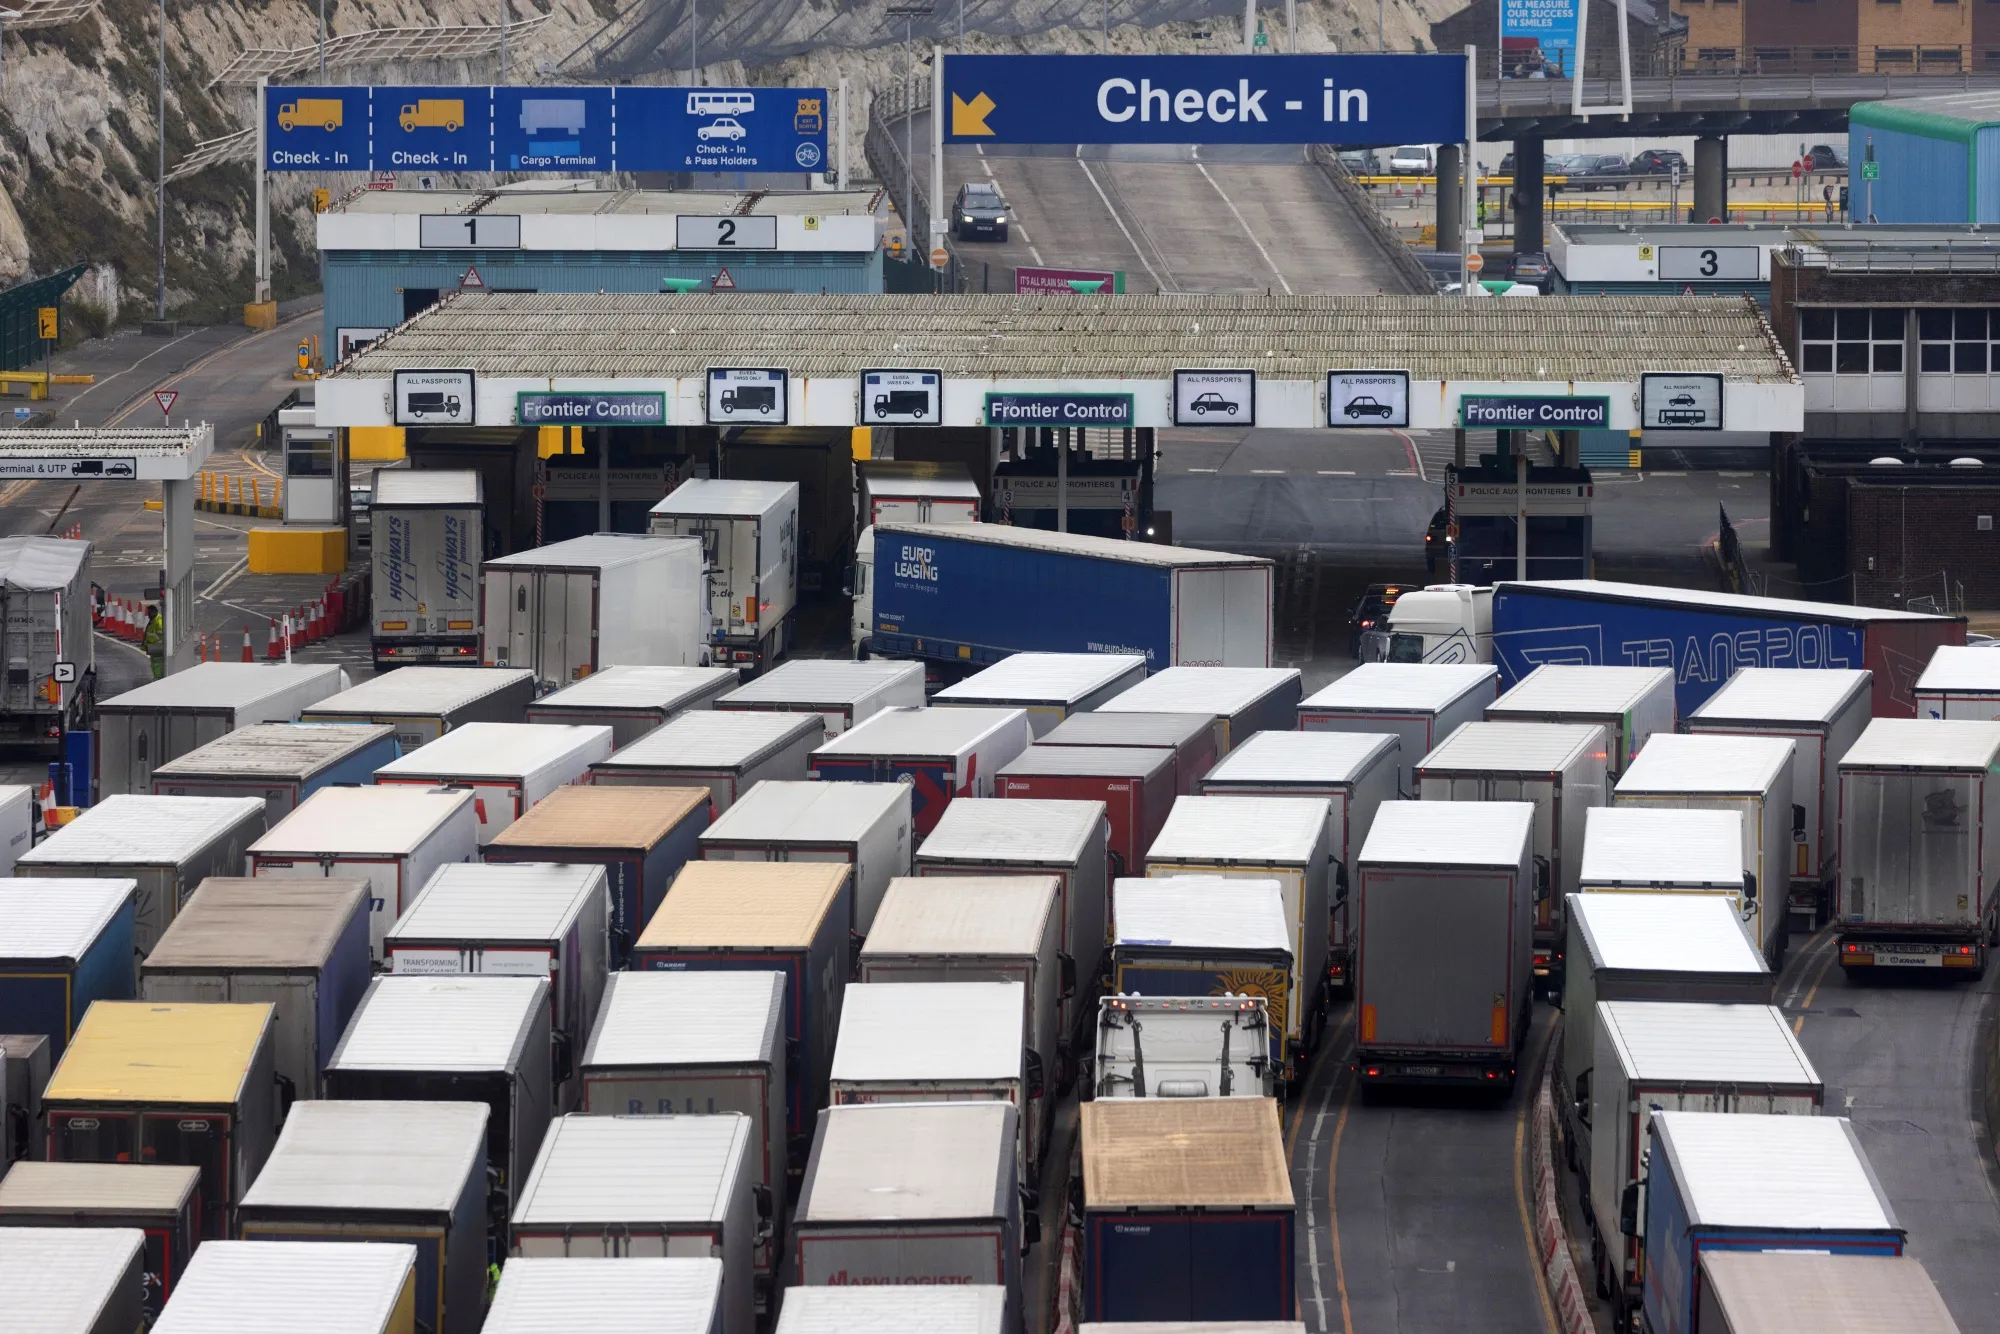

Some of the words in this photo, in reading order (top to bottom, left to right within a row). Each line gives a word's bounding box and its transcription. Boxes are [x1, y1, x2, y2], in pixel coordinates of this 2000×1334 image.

[1508, 0, 1523, 8] WE
[1525, 0, 1570, 8] MEASURE
[1508, 9, 1529, 18] OUR
[1530, 9, 1574, 18] SUCCESS
[1507, 18, 1518, 27] IN
[1519, 18, 1553, 27] SMILES
[1097, 77, 1269, 122] Check
[1323, 78, 1369, 122] in
[696, 144, 728, 154] Check
[736, 145, 746, 154] In
[272, 150, 321, 164] Check
[334, 151, 349, 164] In
[391, 150, 440, 165] Check
[453, 151, 468, 164] In
[520, 155, 552, 167] Cargo
[553, 155, 596, 165] Terminal
[685, 156, 693, 165] &
[694, 156, 718, 165] Pass
[720, 156, 758, 165] Holders
[464, 219, 477, 244] 1
[717, 219, 736, 245] 2
[1700, 249, 1718, 277] 3
[524, 401, 591, 418] Frontier
[595, 401, 660, 418] Control
[991, 402, 1057, 419] Frontier
[1065, 402, 1128, 419] Control
[1467, 404, 1535, 421] Frontier
[1539, 405, 1604, 421] Control
[0, 464, 35, 473] erminal
[38, 464, 45, 473] &
[47, 464, 67, 473] UTP
[666, 463, 673, 473] 2
[557, 472, 587, 480] POLICE
[589, 472, 600, 480] AU
[1449, 474, 1456, 484] 5
[1005, 491, 1012, 502] 3
[1124, 491, 1131, 502] 4
[1470, 487, 1501, 495] POLICE
[388, 515, 402, 602] HIGHWAYS
[445, 514, 459, 600] HIGHWAYS
[894, 561, 939, 581] LEASING
[60, 668, 69, 677] A
[403, 959, 458, 967] TRANSFORMING
